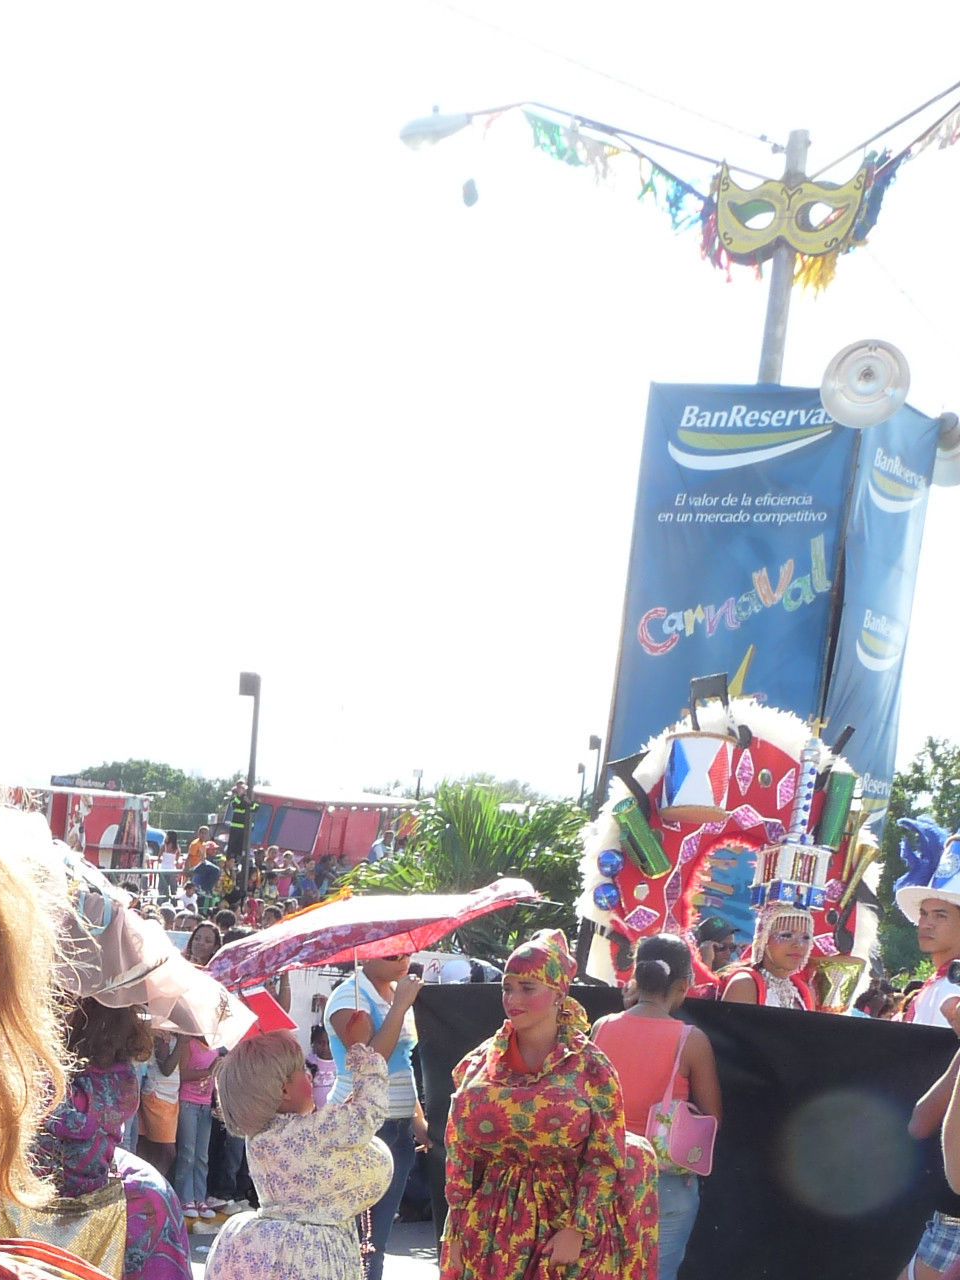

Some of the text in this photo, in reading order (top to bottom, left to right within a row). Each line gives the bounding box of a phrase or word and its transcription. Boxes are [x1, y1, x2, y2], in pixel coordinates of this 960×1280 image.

[874, 447, 928, 490] BanReserva
[675, 492, 813, 506] El valor de la eficiencia
[658, 509, 827, 526] en un mercado competitivo
